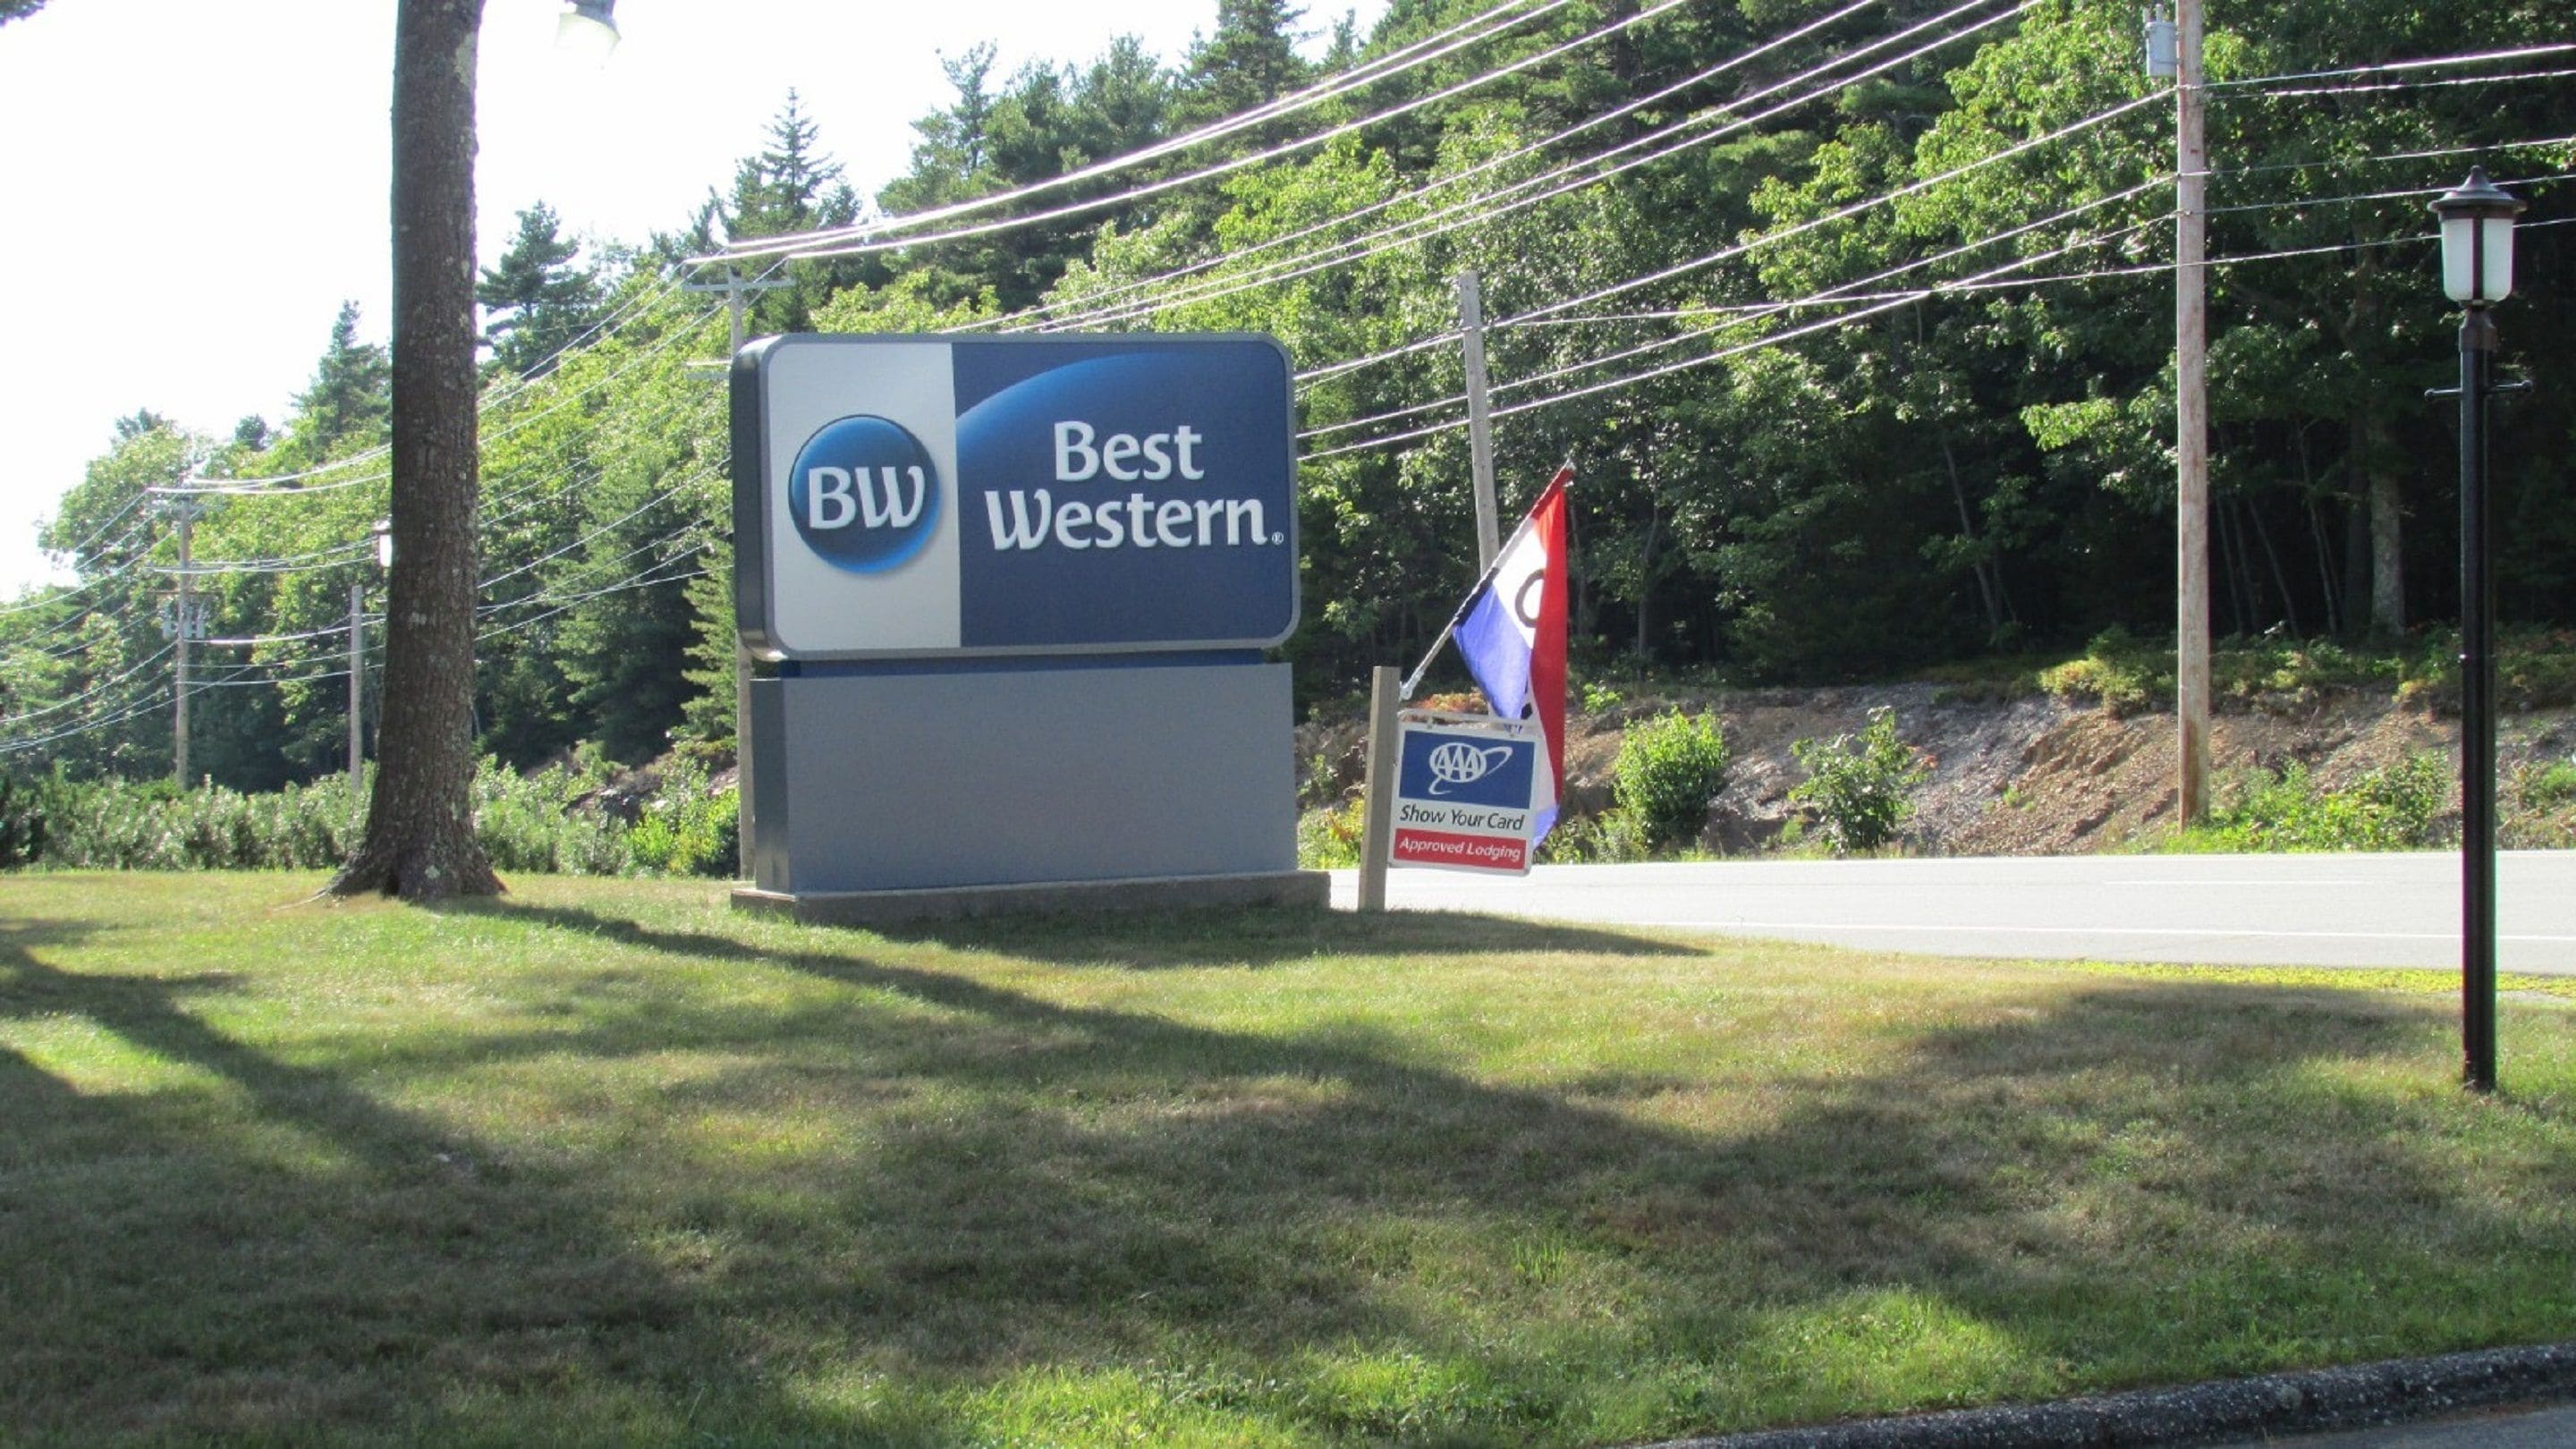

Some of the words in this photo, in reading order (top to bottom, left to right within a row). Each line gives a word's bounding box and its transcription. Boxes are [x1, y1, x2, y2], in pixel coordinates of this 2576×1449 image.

[1054, 420, 1205, 483] Best
[808, 465, 925, 530] BW
[1436, 744, 1481, 782] AAA
[1400, 804, 1445, 822] Show
[1452, 809, 1484, 826] Your
[1487, 814, 1525, 830] Card
[1400, 837, 1465, 853] Approved
[1466, 843, 1521, 860] Lodging
